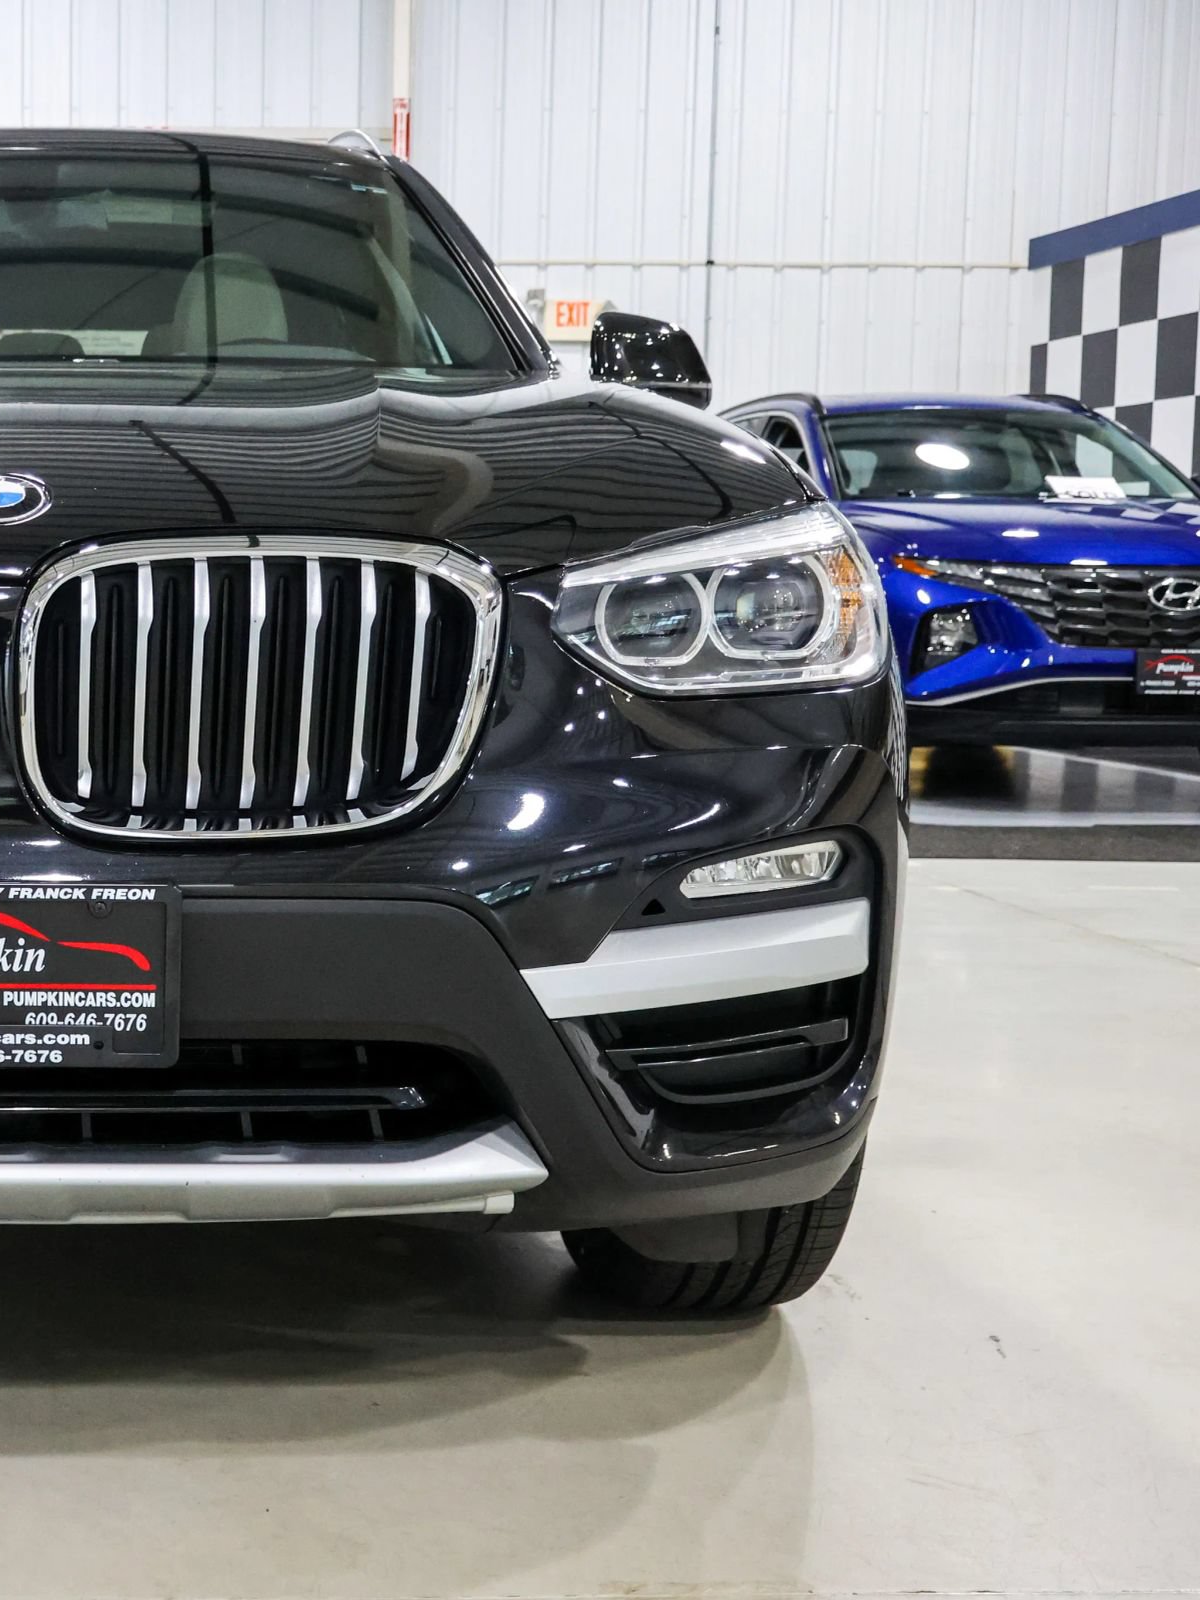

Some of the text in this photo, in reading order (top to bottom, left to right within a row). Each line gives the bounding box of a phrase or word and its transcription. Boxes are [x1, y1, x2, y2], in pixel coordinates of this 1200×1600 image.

[555, 300, 591, 328] EXIT
[8, 887, 87, 900] FRANCK
[90, 888, 156, 900] FREON
[3, 991, 156, 1008] PUMPKINCARS.COM
